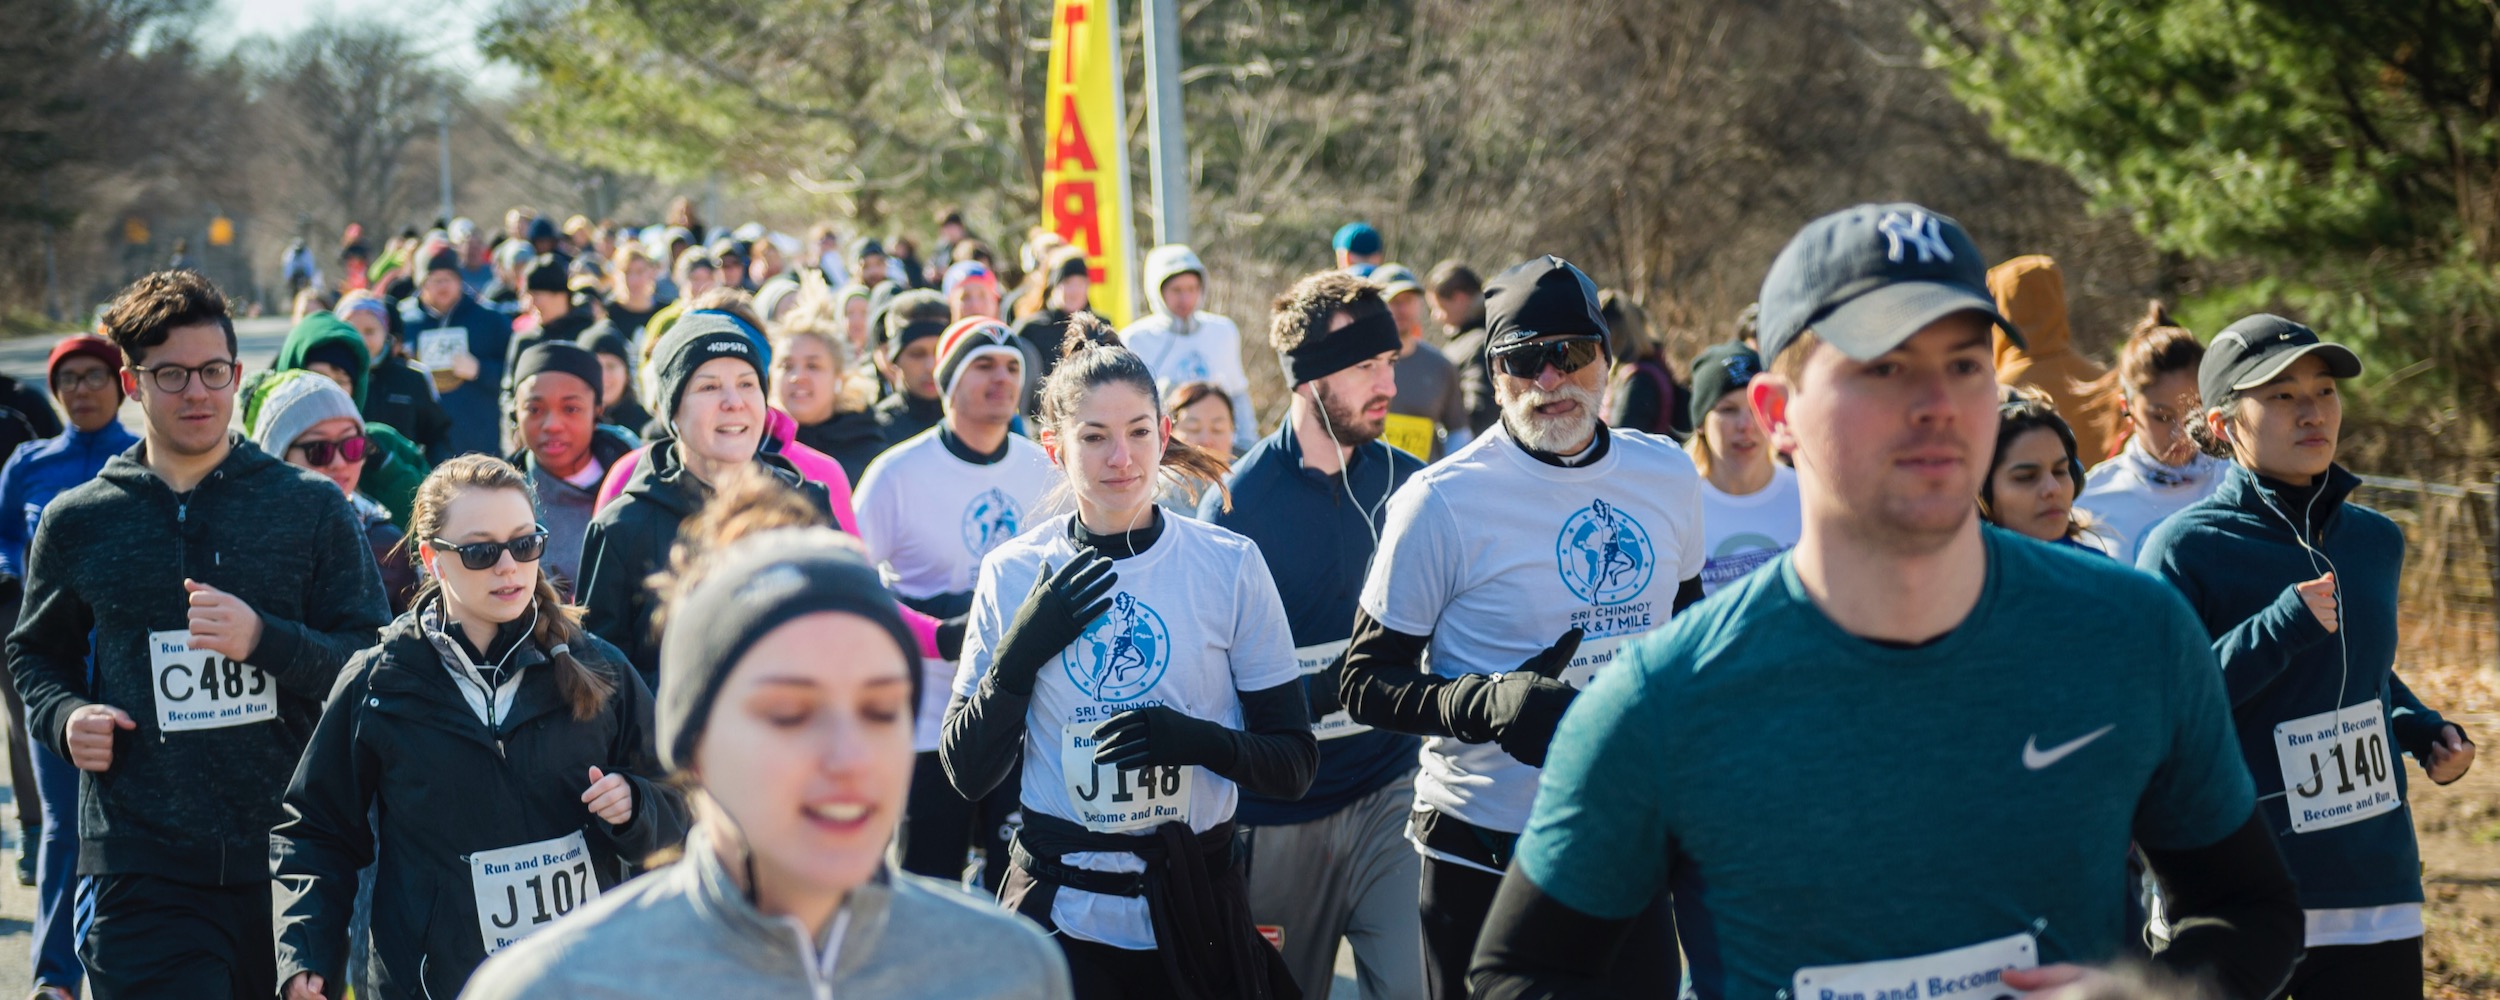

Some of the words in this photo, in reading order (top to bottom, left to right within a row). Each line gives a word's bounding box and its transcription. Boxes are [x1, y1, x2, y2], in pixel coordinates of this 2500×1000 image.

[1570, 610, 1590, 621] SRI
[1595, 602, 1652, 617] CHINMOY
[1594, 621, 1604, 632] &
[1604, 618, 1614, 630] 7
[1618, 613, 1652, 629] MILE
[162, 643, 184, 653] Run
[1592, 650, 1613, 664] and
[168, 711, 215, 721] Become
[220, 706, 241, 716] and
[246, 703, 268, 713] Run
[1075, 706, 1096, 717] SRI
[2288, 732, 2313, 746] Run
[2317, 725, 2339, 740] and
[2342, 716, 2377, 734] Become
[1084, 811, 1126, 823] Become
[1131, 807, 1151, 821] and
[1155, 804, 1178, 816] Run
[2304, 804, 2353, 821] Become
[2356, 795, 2374, 810] and
[2375, 791, 2390, 804] Run
[484, 863, 510, 875] Run
[514, 857, 539, 871] and
[543, 846, 582, 866] Become
[1876, 981, 1919, 1000] and
[1927, 965, 2015, 997] Becom
